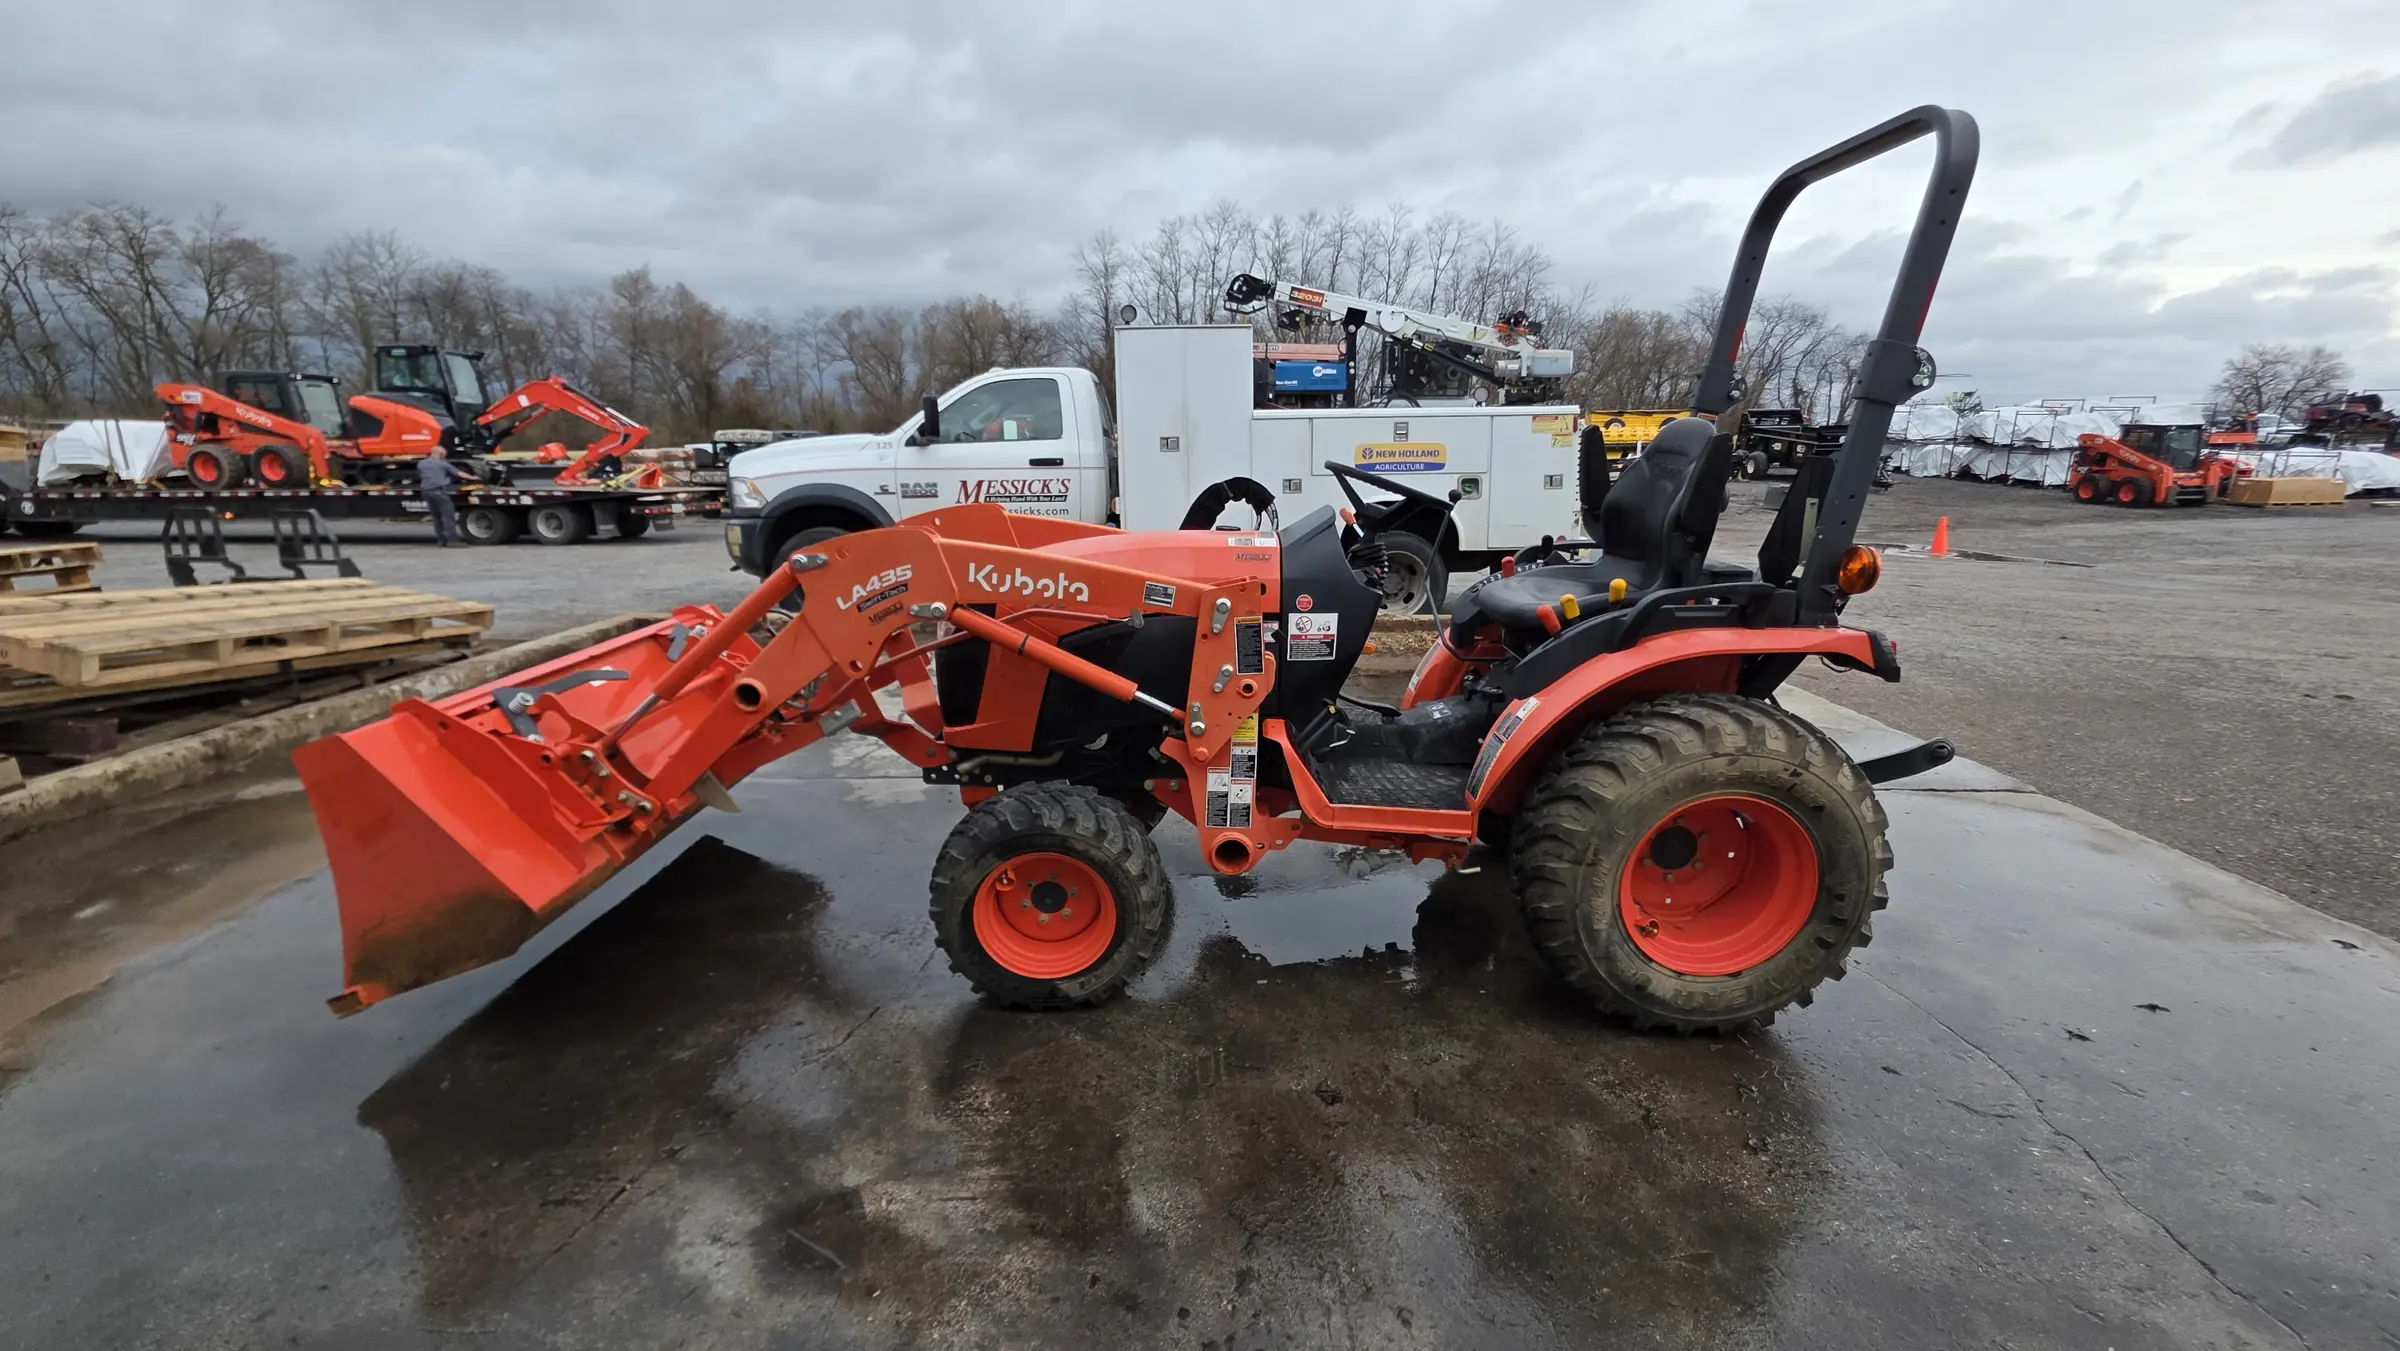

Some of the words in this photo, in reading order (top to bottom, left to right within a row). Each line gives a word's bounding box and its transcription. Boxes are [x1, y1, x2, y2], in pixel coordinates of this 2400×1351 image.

[1375, 450, 1397, 458] NEW
[1398, 449, 1440, 458] HOLLAND
[1374, 463, 1425, 471] AGRICULTURE
[955, 477, 1071, 504] MESSICK'S
[1008, 506, 1069, 517] ssicks.com
[836, 564, 912, 610] LA435
[968, 562, 1089, 602] Kubota
